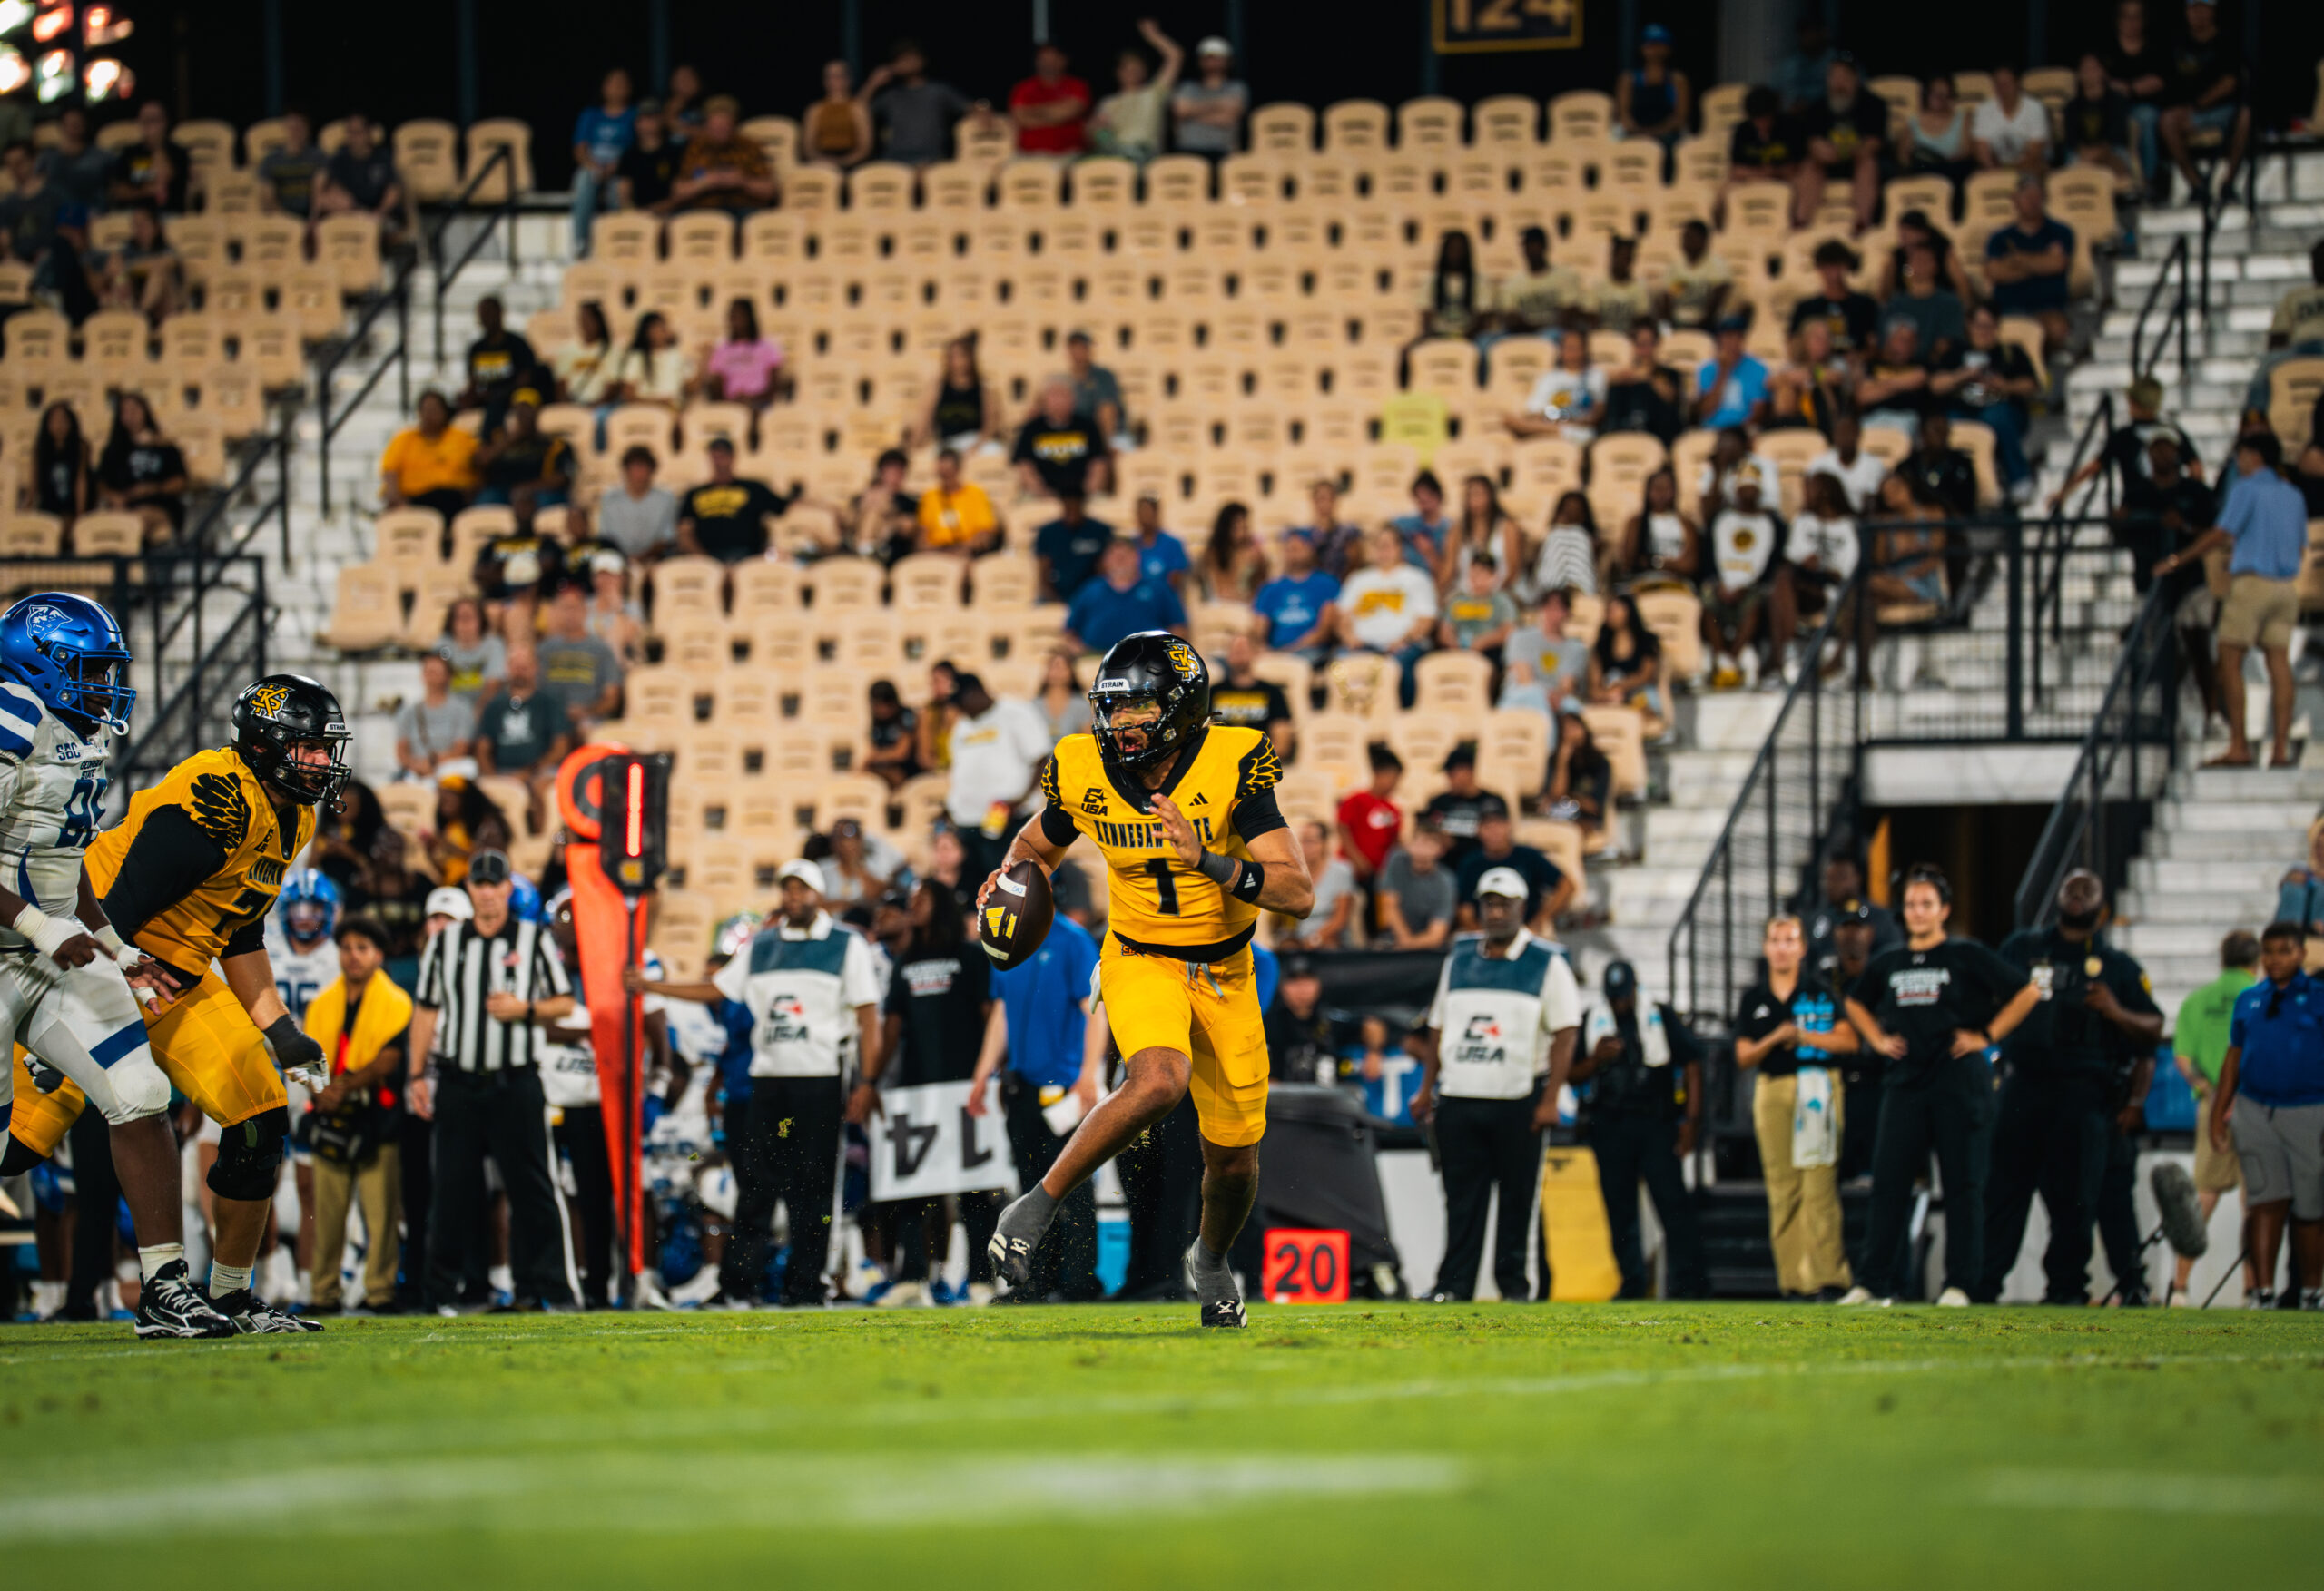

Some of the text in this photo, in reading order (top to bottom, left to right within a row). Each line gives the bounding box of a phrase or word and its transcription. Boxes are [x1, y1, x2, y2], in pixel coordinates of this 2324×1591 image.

[56, 742, 81, 761] SBC
[1081, 803, 1108, 817] USA
[1093, 820, 1164, 849] KENNESAW
[1144, 857, 1180, 917] 1
[766, 1026, 809, 1043] USA
[1456, 1046, 1505, 1064] USA
[1275, 1242, 1336, 1294] 20
